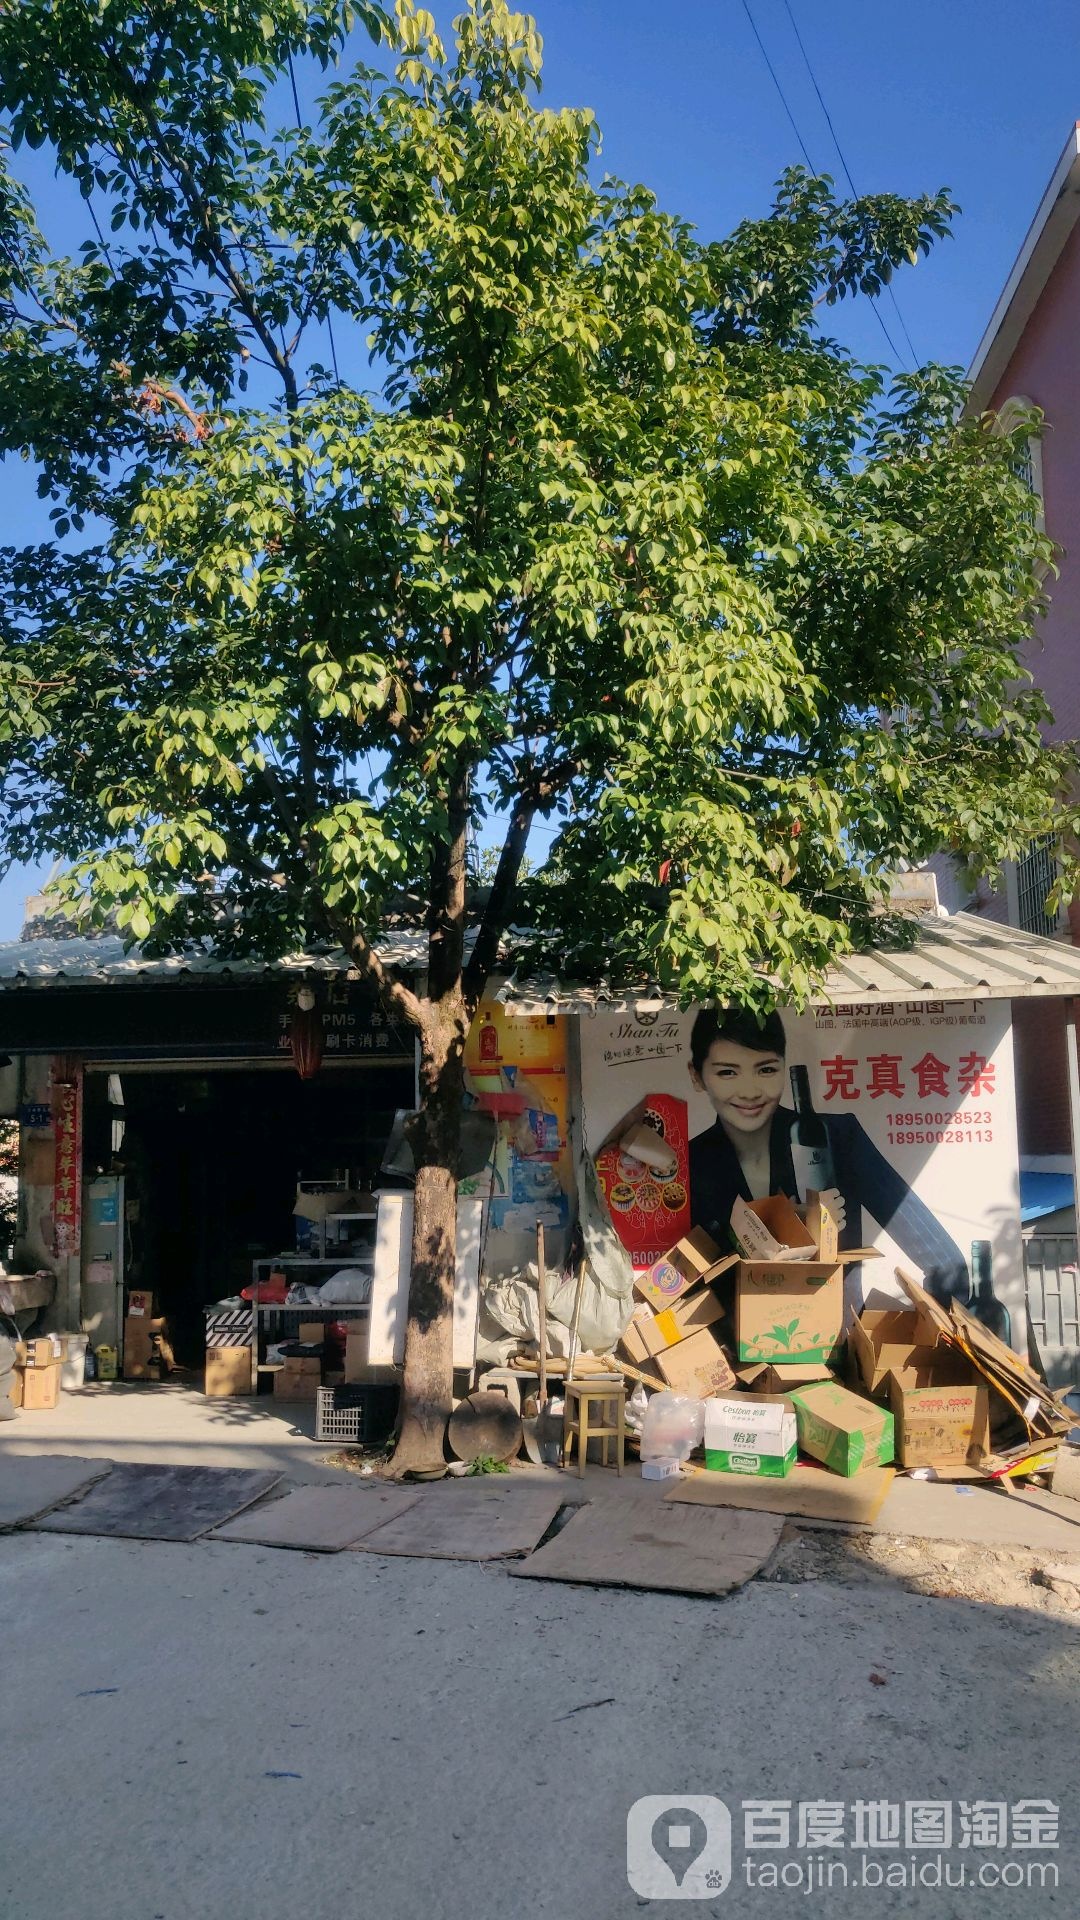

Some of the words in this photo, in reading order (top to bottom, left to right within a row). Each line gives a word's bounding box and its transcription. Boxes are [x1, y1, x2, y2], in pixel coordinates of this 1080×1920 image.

[610, 1024, 652, 1038] Shan
[656, 1023, 679, 1038] Tu
[326, 1033, 390, 1049] 刷卡消费
[820, 1051, 996, 1101] 克真食杂
[886, 1111, 992, 1126] 18950028523
[887, 1130, 993, 1145] 18950028113
[722, 1405, 751, 1416] Cestbon
